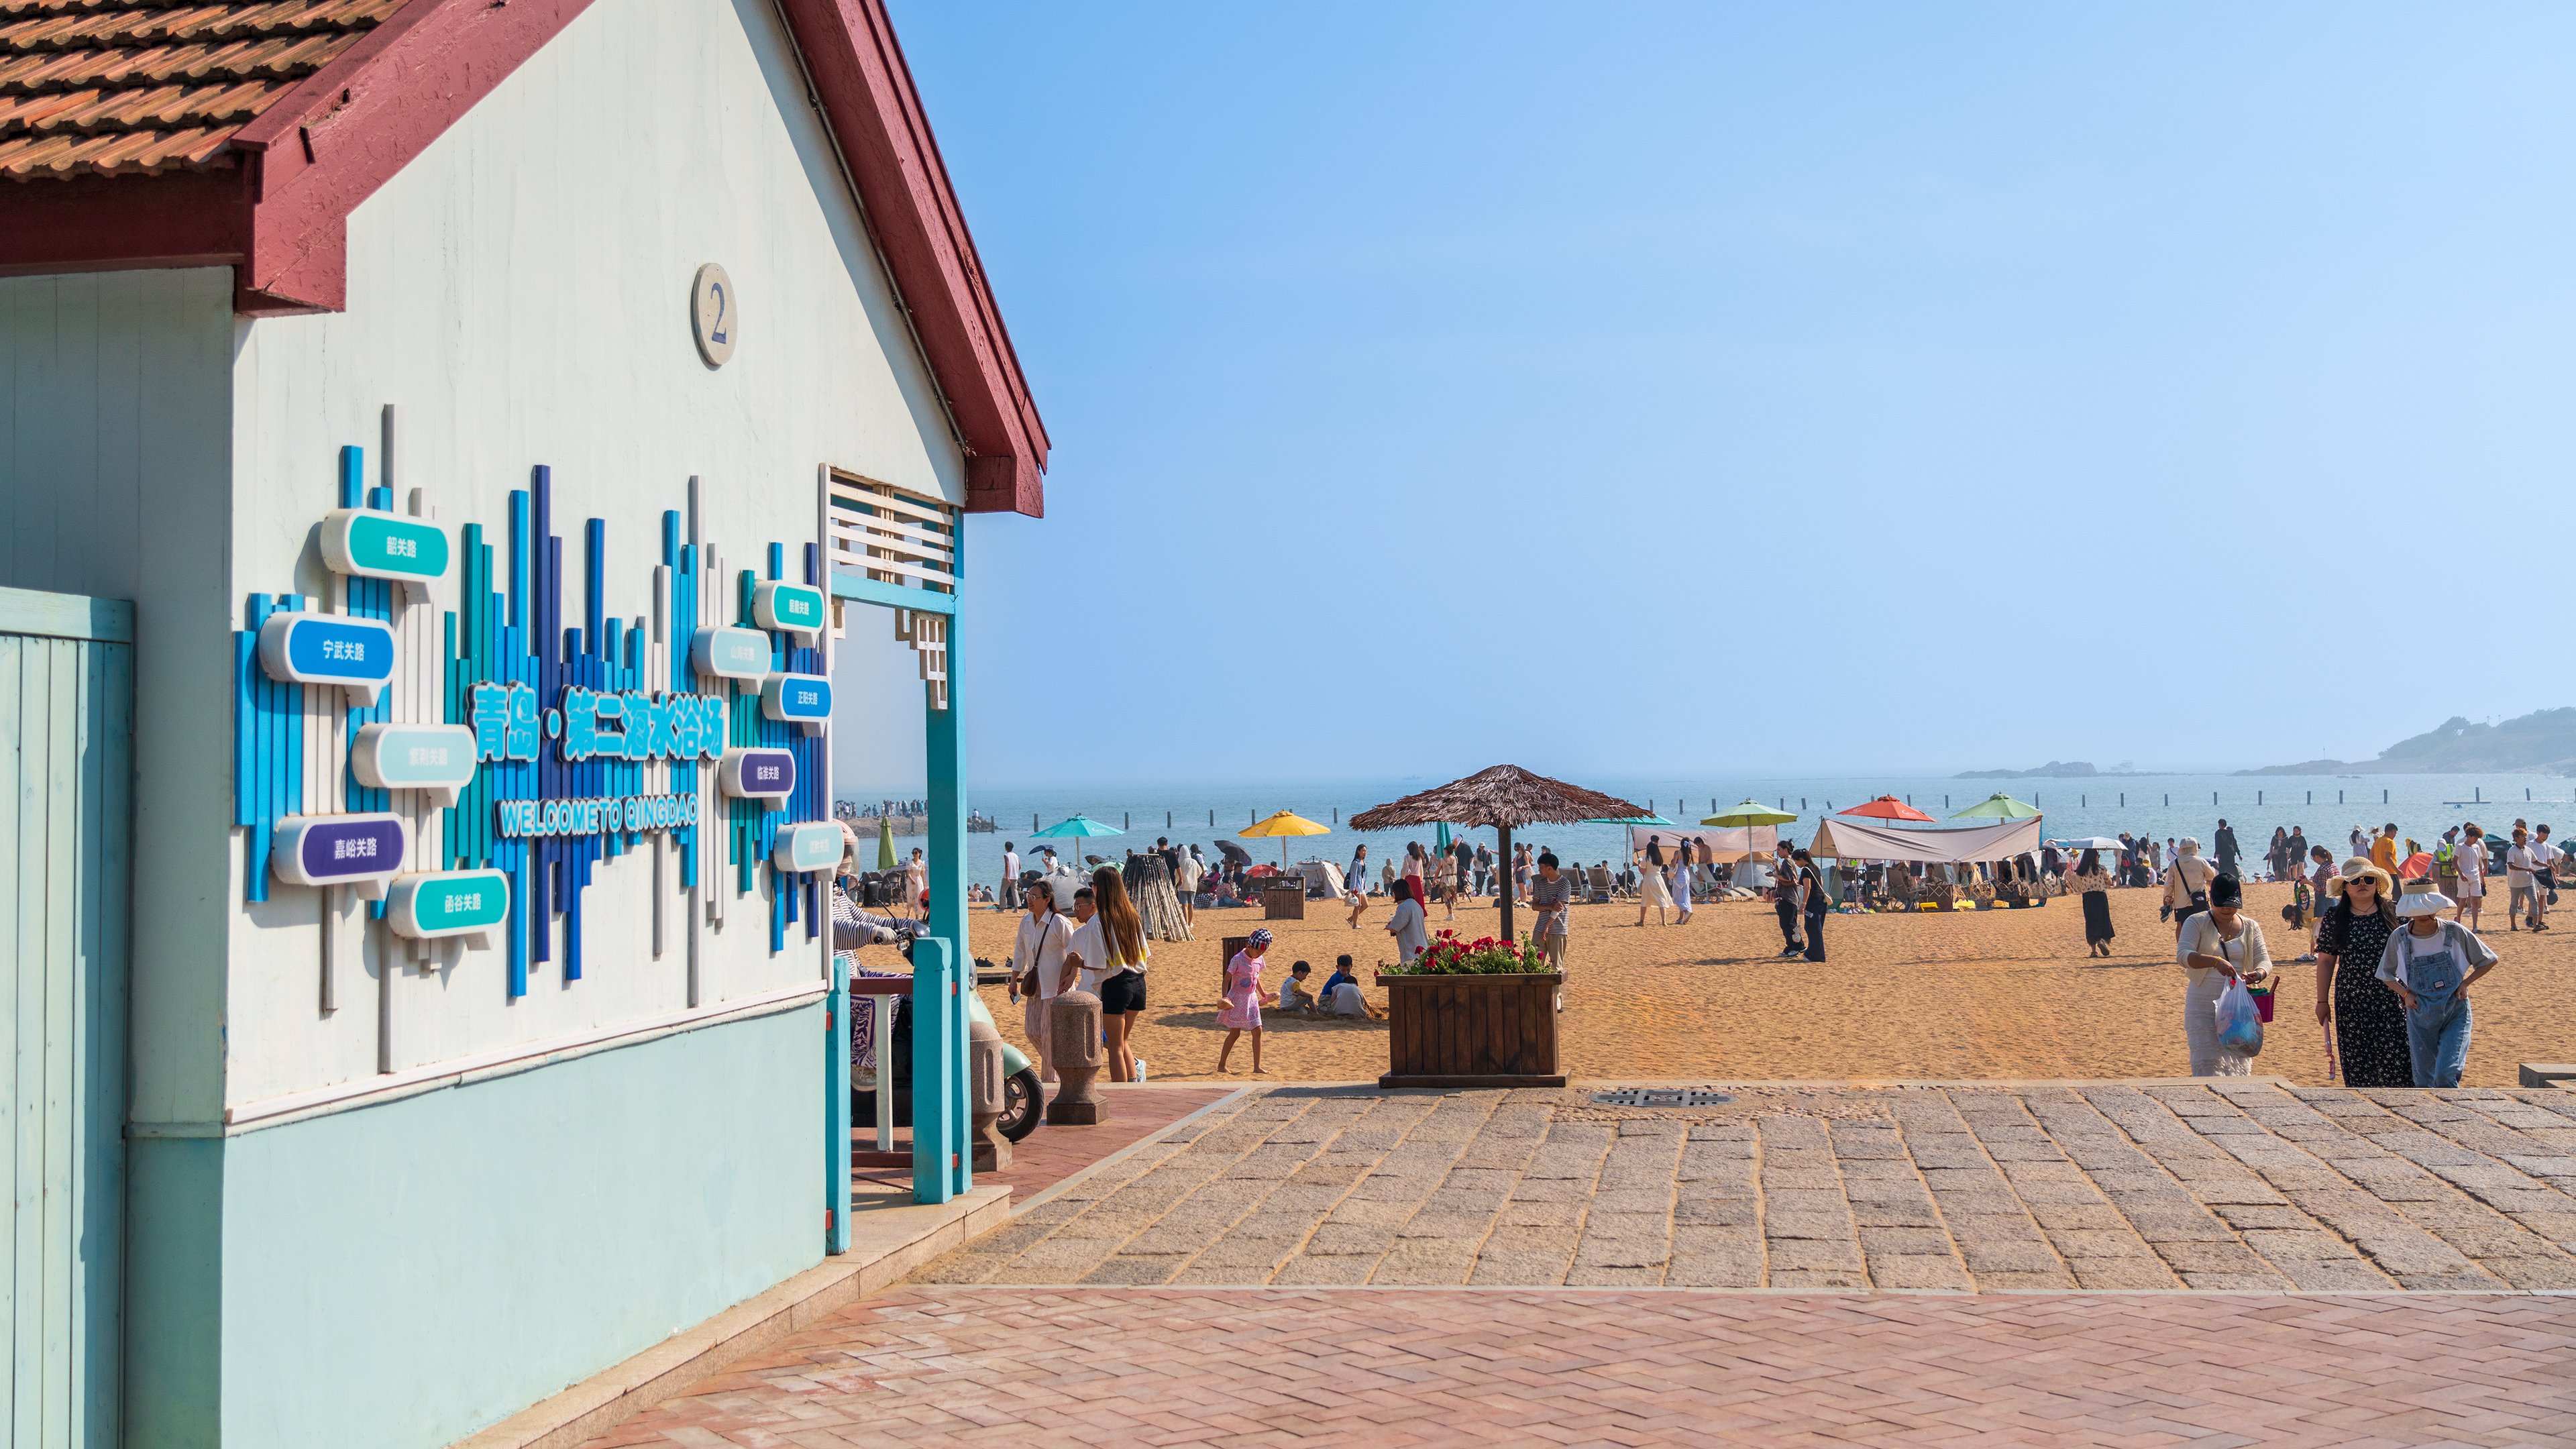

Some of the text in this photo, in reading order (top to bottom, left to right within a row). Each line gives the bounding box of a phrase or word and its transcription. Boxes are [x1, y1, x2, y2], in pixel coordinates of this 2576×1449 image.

[710, 282, 727, 345] 2
[386, 536, 417, 559] 韶关路
[323, 639, 364, 661] 宁武关路
[798, 691, 818, 705] 正阳关路
[625, 793, 698, 832] QINGDAO
[334, 837, 377, 859] 嘉峪关路
[445, 892, 482, 913] 函谷关路
